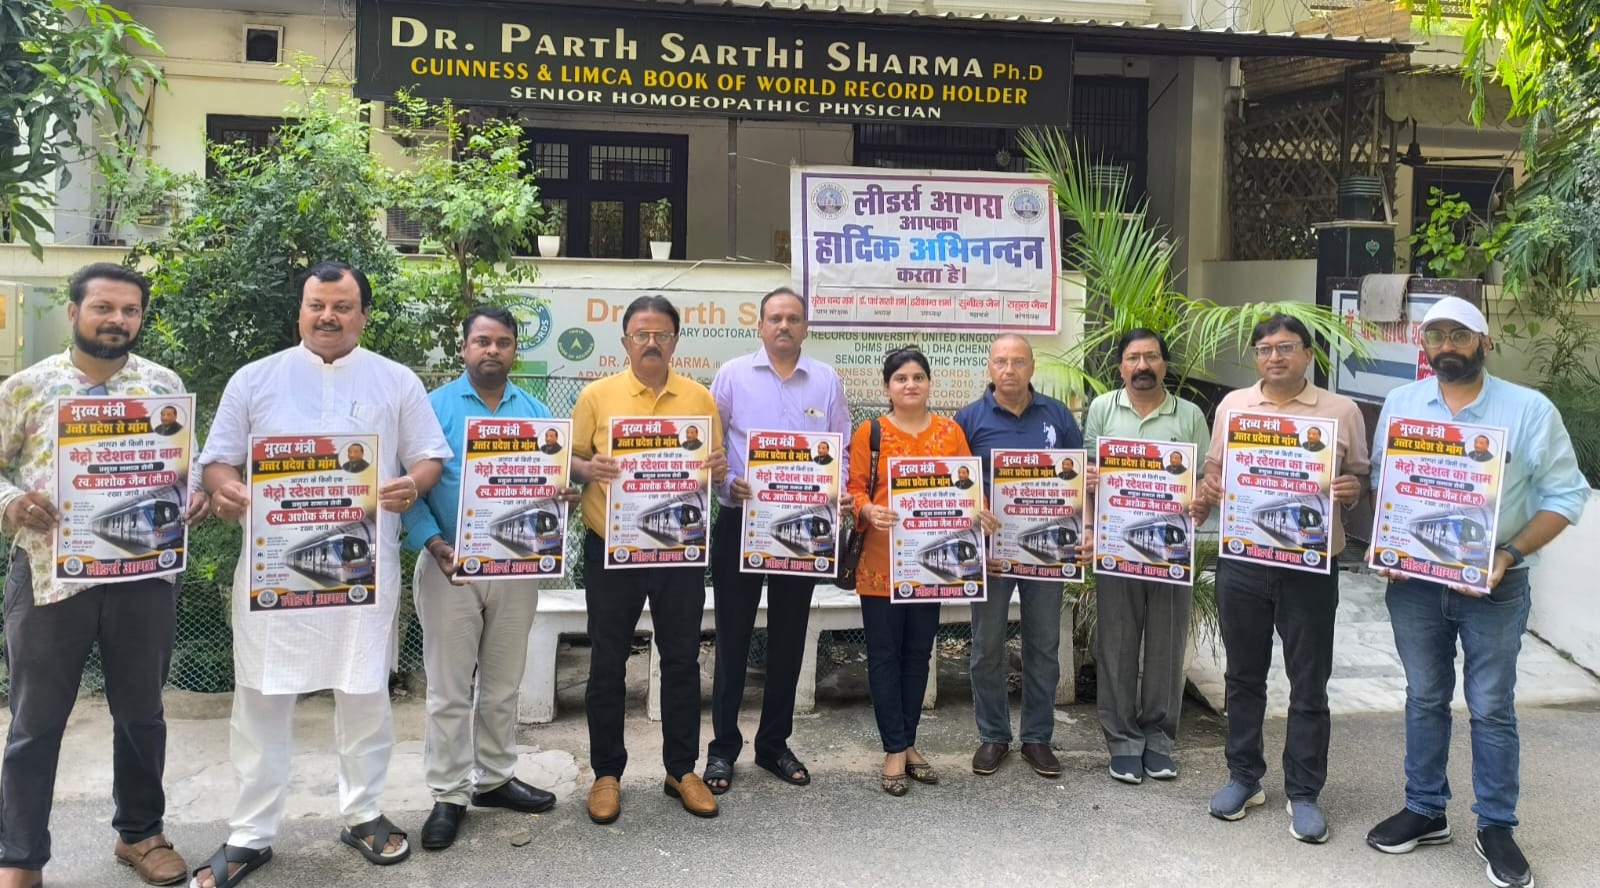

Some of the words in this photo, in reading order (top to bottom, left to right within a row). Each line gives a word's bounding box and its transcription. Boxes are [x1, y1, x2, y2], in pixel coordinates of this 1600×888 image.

[993, 63, 1043, 81] Ph.D
[410, 56, 528, 80] GUINNESS
[537, 63, 552, 81] &
[560, 65, 632, 86] LIMCA
[644, 69, 708, 90] BOOK
[717, 73, 746, 91] OF
[756, 75, 836, 96] WORLD
[844, 80, 934, 100] RECORD
[942, 84, 1028, 104] HOLDER
[510, 86, 602, 103] SENIOR
[612, 91, 810, 113] HOMOEOPATHIC
[819, 101, 941, 118] PHYSICIAN
[852, 184, 922, 216] लीडर्स
[930, 191, 1003, 219] आगरा
[899, 215, 959, 231] आपका
[813, 223, 900, 264] हार्दिक
[910, 231, 1044, 269] अभिनन्दन
[896, 267, 943, 283] करता
[959, 297, 984, 310] सुनील
[985, 298, 1000, 308] जैन
[1007, 300, 1029, 311] राहुल
[1031, 299, 1048, 310] जैन
[811, 331, 858, 341] RECORDS
[922, 332, 957, 342] UNITED
[854, 342, 882, 352] DHMS
[932, 344, 953, 354] DHA
[835, 354, 871, 365] SENIOR
[70, 404, 99, 421] मुख्य
[103, 402, 126, 416] मंत्री
[478, 425, 500, 438] मुख्य
[502, 424, 520, 436] मंत्री
[645, 422, 661, 433] मंत्री
[1238, 417, 1260, 432] मुख्य
[1262, 418, 1280, 431] मंत्री
[1399, 423, 1423, 438] मुख्य
[1426, 424, 1445, 438] मंत्री
[69, 448, 92, 466] मेट्रो
[96, 446, 134, 462] स्टेशन
[138, 449, 154, 459] का
[159, 447, 183, 459] नाम
[264, 442, 290, 458] मुख्य
[294, 440, 315, 454] मंत्री
[1130, 444, 1145, 455] मंत्री
[282, 457, 304, 470] प्रदेश
[308, 457, 315, 469] से
[318, 457, 336, 469] मांग
[474, 461, 493, 476] मेट्रो
[495, 462, 524, 474] स्टेशन
[527, 465, 540, 474] का
[543, 465, 562, 474] नाम
[620, 458, 637, 472] मेट्रो
[640, 458, 667, 469] स्टेशन
[670, 460, 682, 469] का
[920, 462, 935, 473] मंत्री
[1236, 451, 1254, 466] मेट्रो
[1256, 453, 1285, 468] स्टेशन
[1289, 459, 1302, 469] का
[1305, 461, 1325, 472] नाम
[802, 474, 813, 482] का
[816, 474, 833, 483] नाम
[1395, 458, 1415, 475] मेट्रो
[1417, 461, 1449, 477] स्टेशन
[1452, 469, 1467, 480] का
[1470, 471, 1492, 484] नाम
[77, 478, 91, 487] स्व.
[95, 474, 125, 487] अशोक
[128, 473, 145, 484] जैन
[1107, 474, 1123, 489] मेट्रो
[1125, 477, 1151, 489] स्टेशन
[1154, 482, 1166, 491] का
[1169, 483, 1187, 493] नाम
[264, 484, 285, 501] मेट्रो
[289, 483, 324, 497] स्टेशन
[328, 485, 343, 495] का
[347, 484, 370, 495] नाम
[1061, 489, 1078, 497] नाम
[900, 497, 915, 510] मेट्रो
[918, 497, 942, 508] स्टेशन
[945, 499, 956, 507] का
[959, 498, 975, 507] नाम
[272, 512, 284, 521] स्व.
[288, 510, 316, 522] अशोक
[319, 509, 335, 520] जैन
